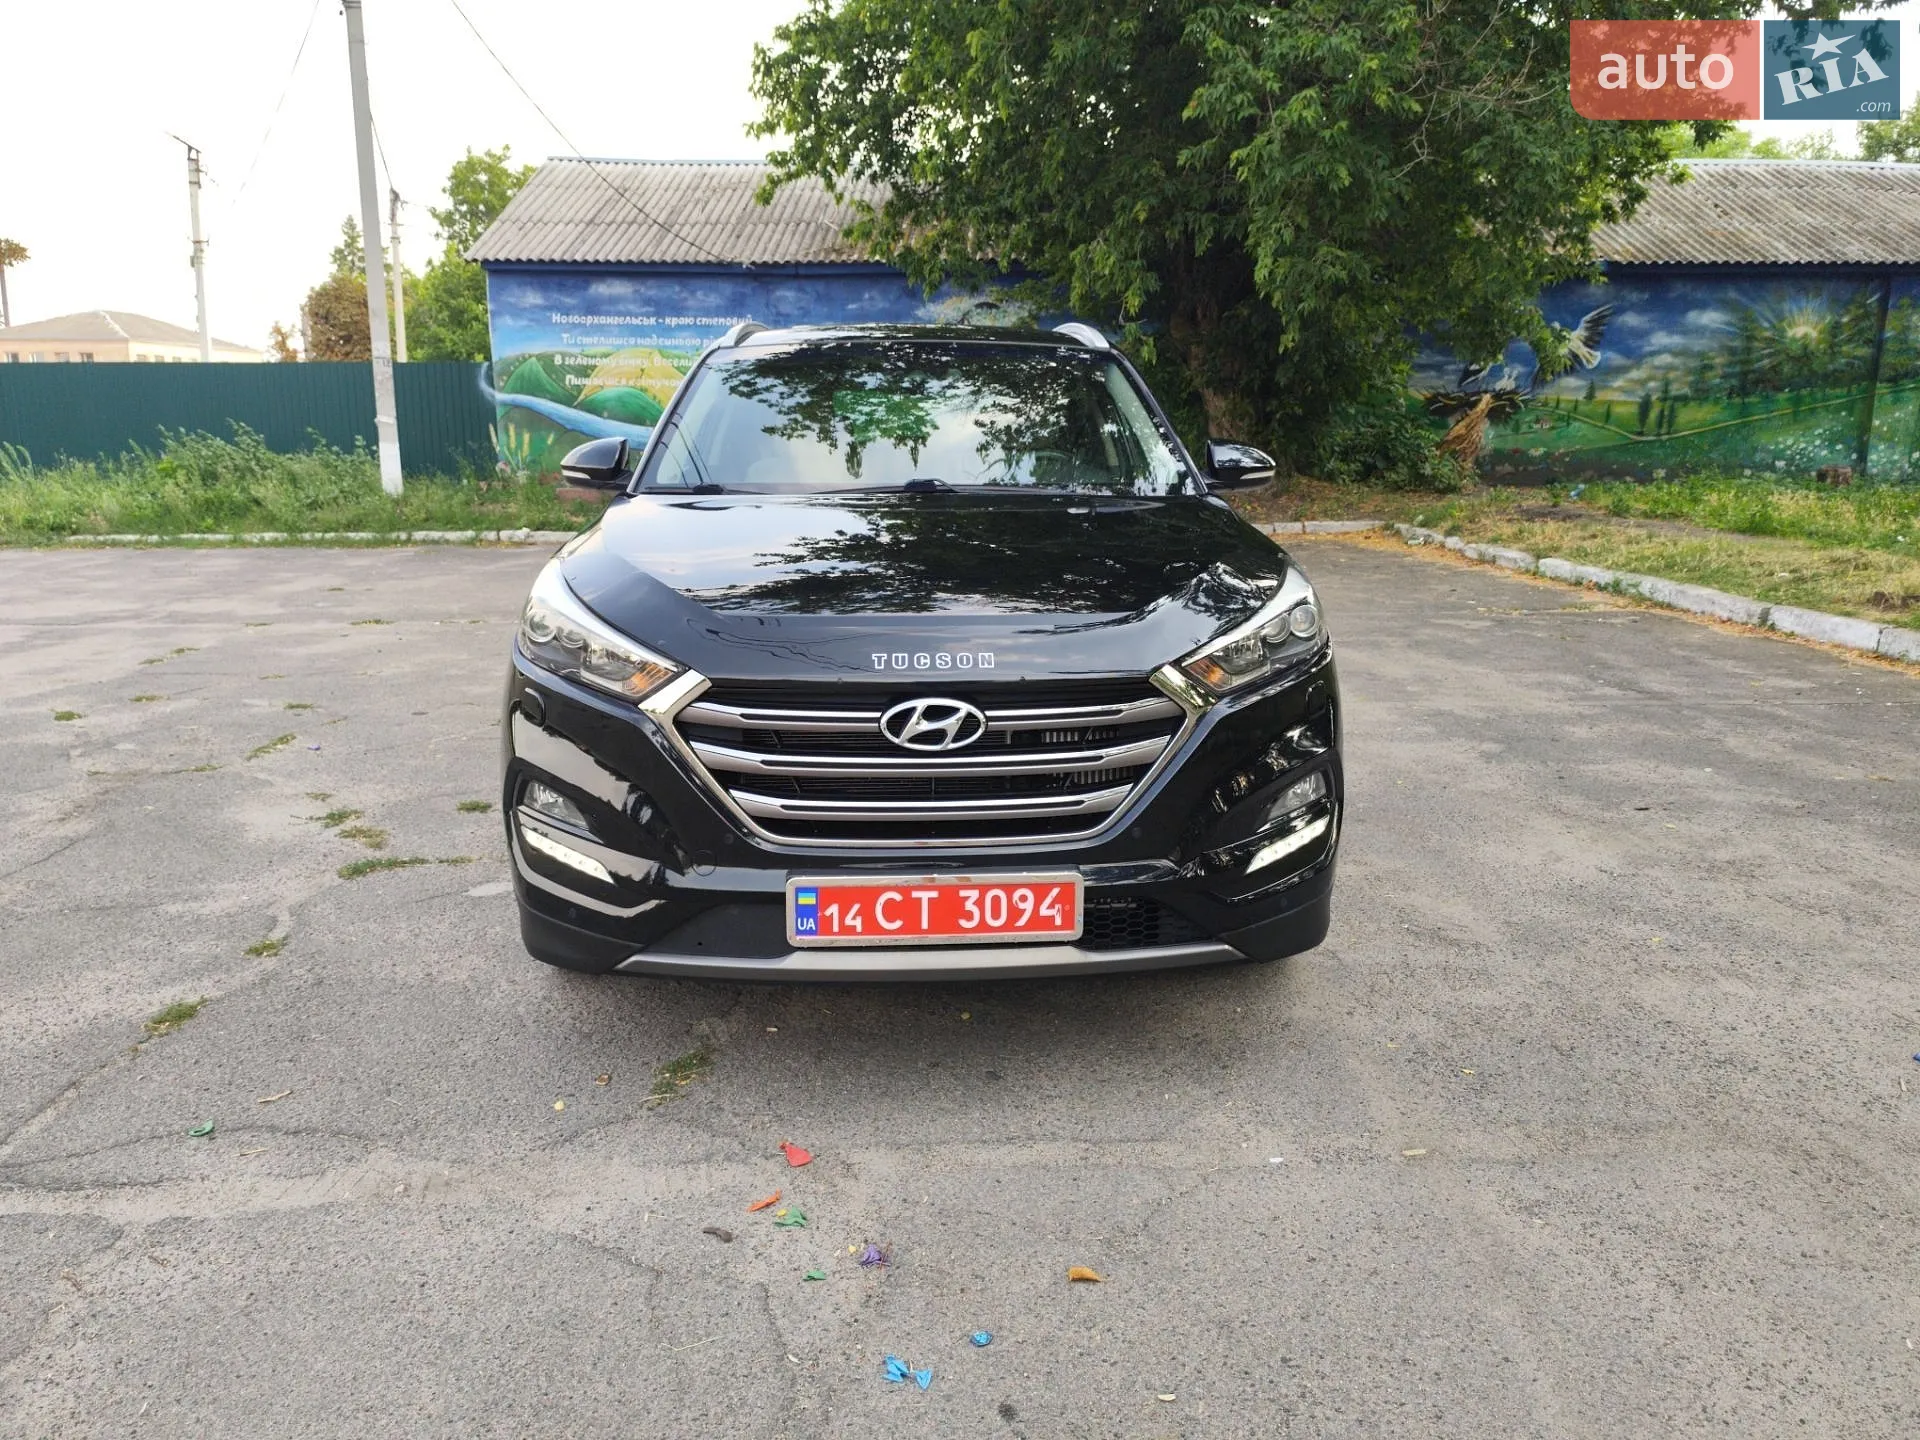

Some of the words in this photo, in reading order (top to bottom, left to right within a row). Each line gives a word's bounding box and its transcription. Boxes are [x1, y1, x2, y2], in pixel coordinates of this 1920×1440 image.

[552, 312, 656, 327] Новоархангельськ
[665, 316, 694, 328] краю
[562, 333, 574, 345] Ти
[638, 334, 657, 345] над
[658, 337, 702, 346] синьою
[554, 354, 562, 365] В
[872, 652, 995, 669] TUCSON
[797, 917, 816, 931] UA
[824, 903, 862, 933] 14
[875, 890, 938, 930] CT
[958, 887, 1062, 929] 3094
